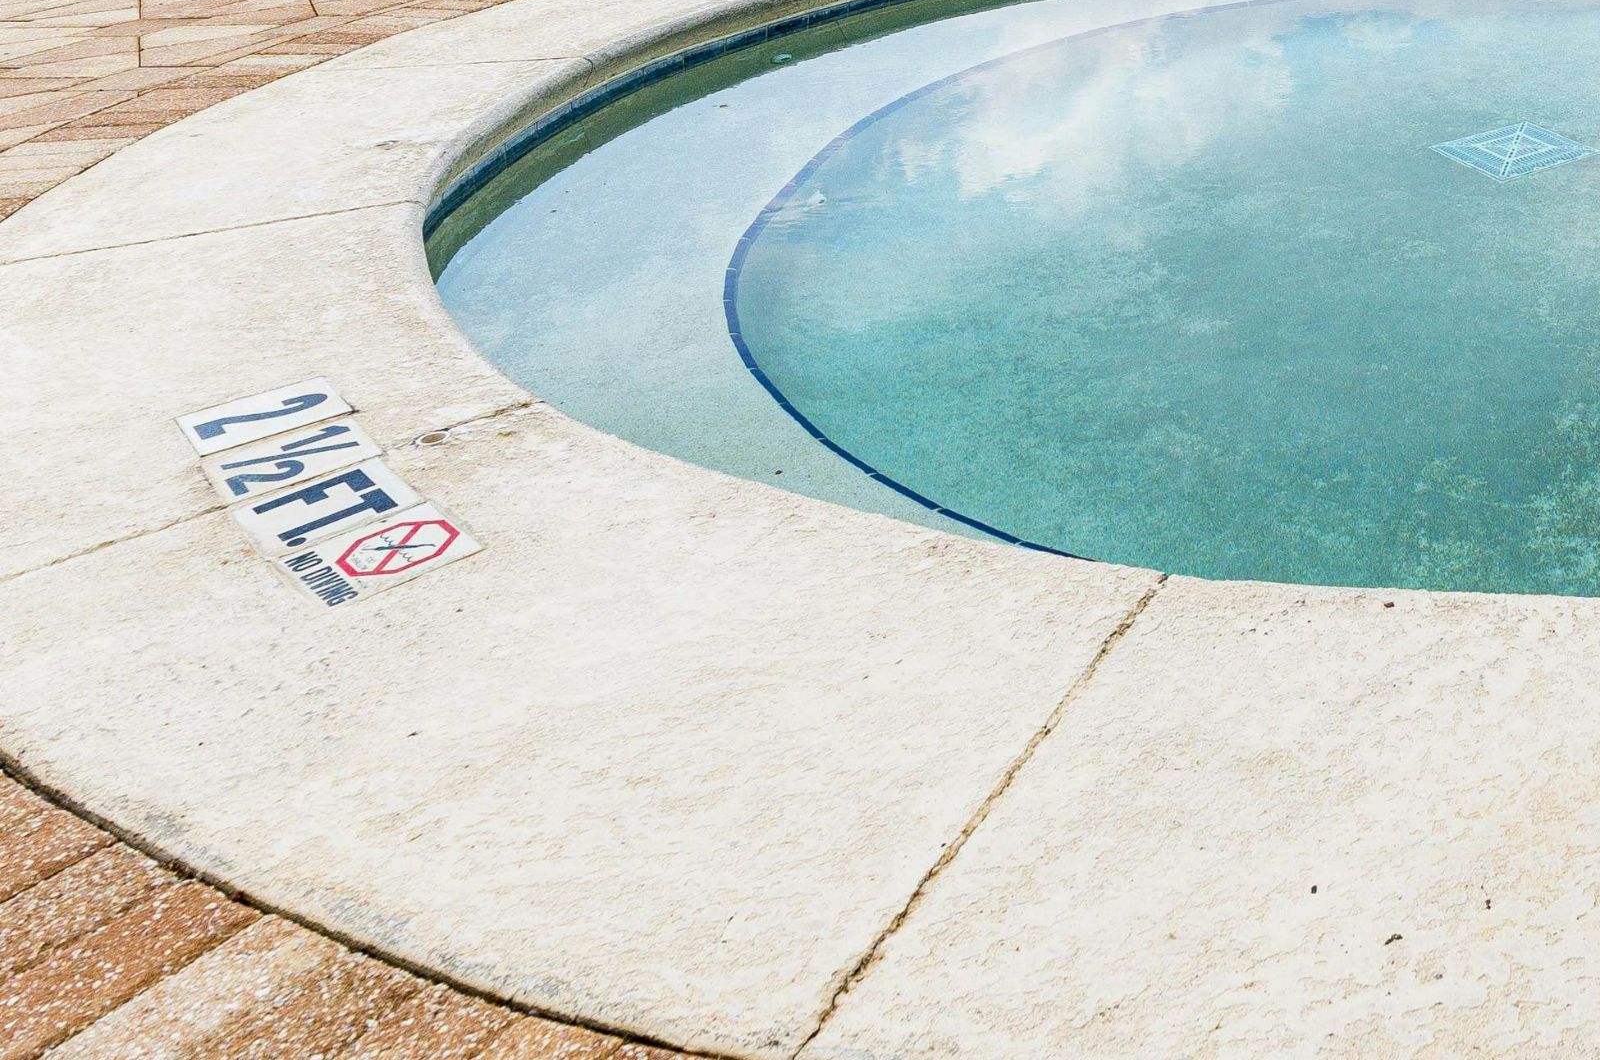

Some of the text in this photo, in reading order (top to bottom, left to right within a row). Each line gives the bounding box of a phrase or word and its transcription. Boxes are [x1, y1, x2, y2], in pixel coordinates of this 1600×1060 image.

[193, 393, 328, 440] 2
[252, 468, 399, 548] FT.
[284, 551, 359, 607] NO DIVING
